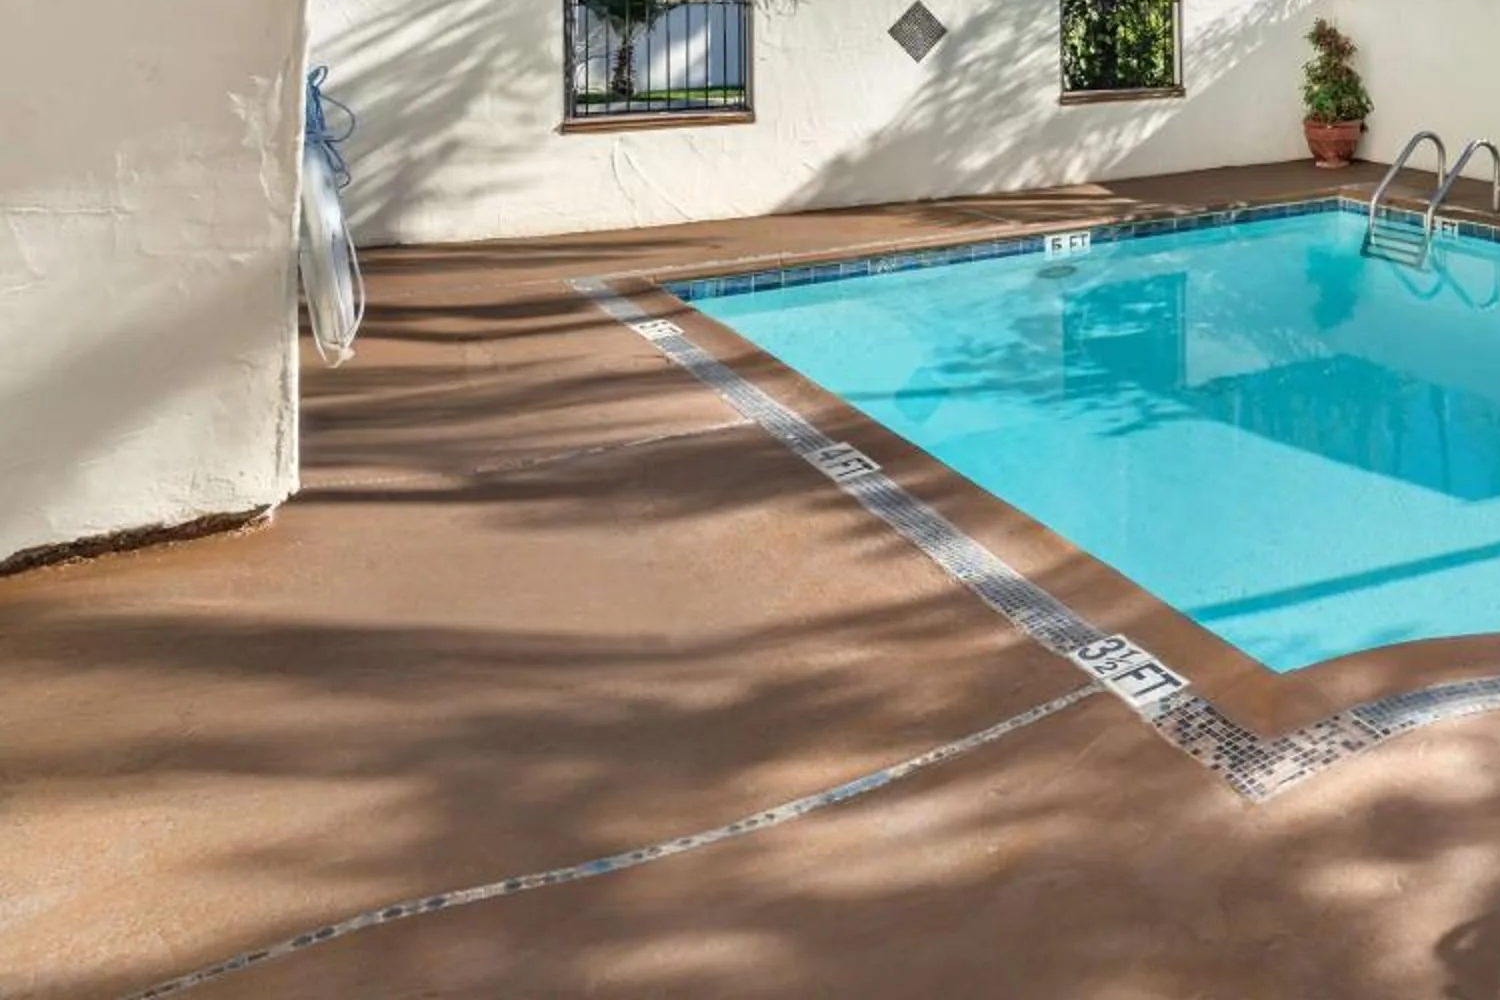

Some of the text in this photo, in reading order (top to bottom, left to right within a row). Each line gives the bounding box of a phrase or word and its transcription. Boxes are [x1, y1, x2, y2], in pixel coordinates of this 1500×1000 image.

[1069, 234, 1089, 249] FT
[826, 457, 874, 477] FT
[1111, 662, 1183, 698] FT
